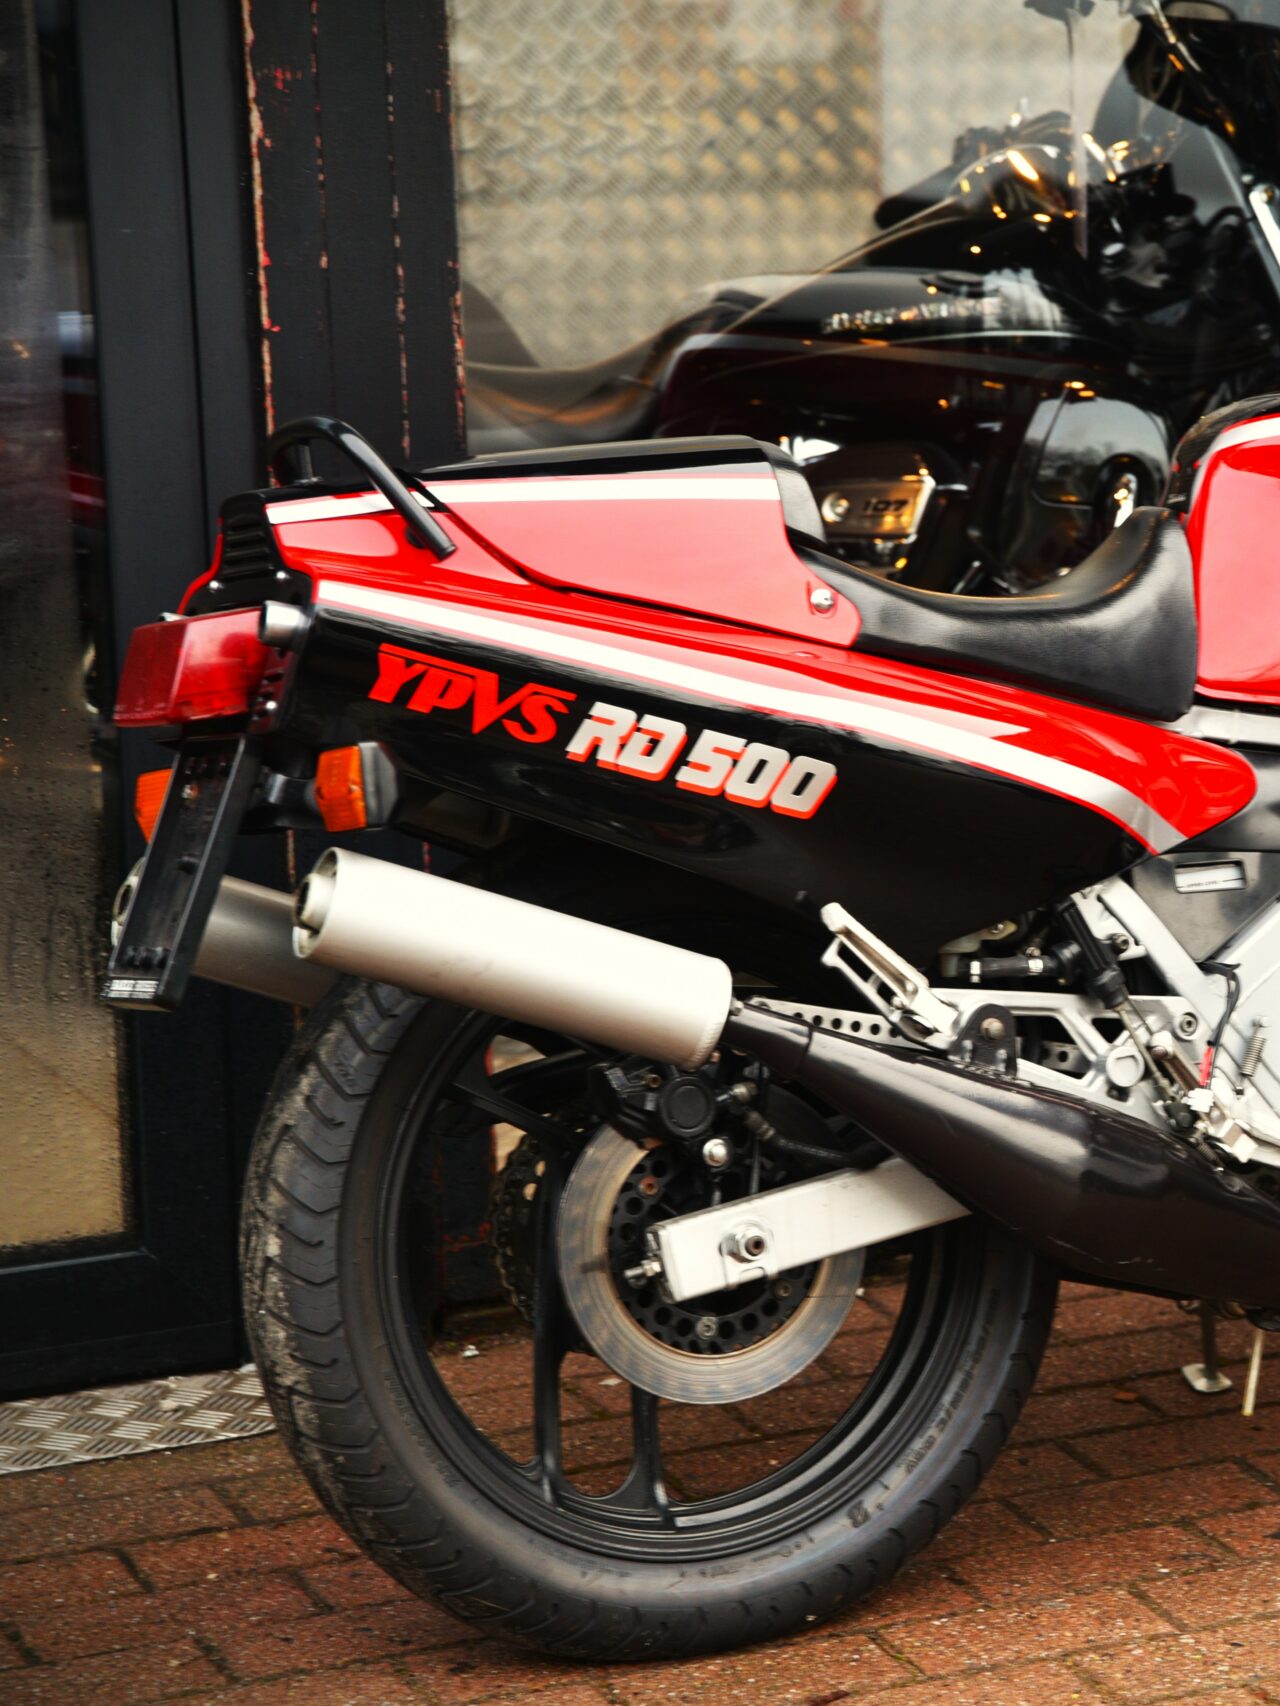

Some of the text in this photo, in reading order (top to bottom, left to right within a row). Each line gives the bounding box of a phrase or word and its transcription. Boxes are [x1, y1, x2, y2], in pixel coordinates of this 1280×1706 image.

[368, 642, 838, 820] YPVS RD 500
